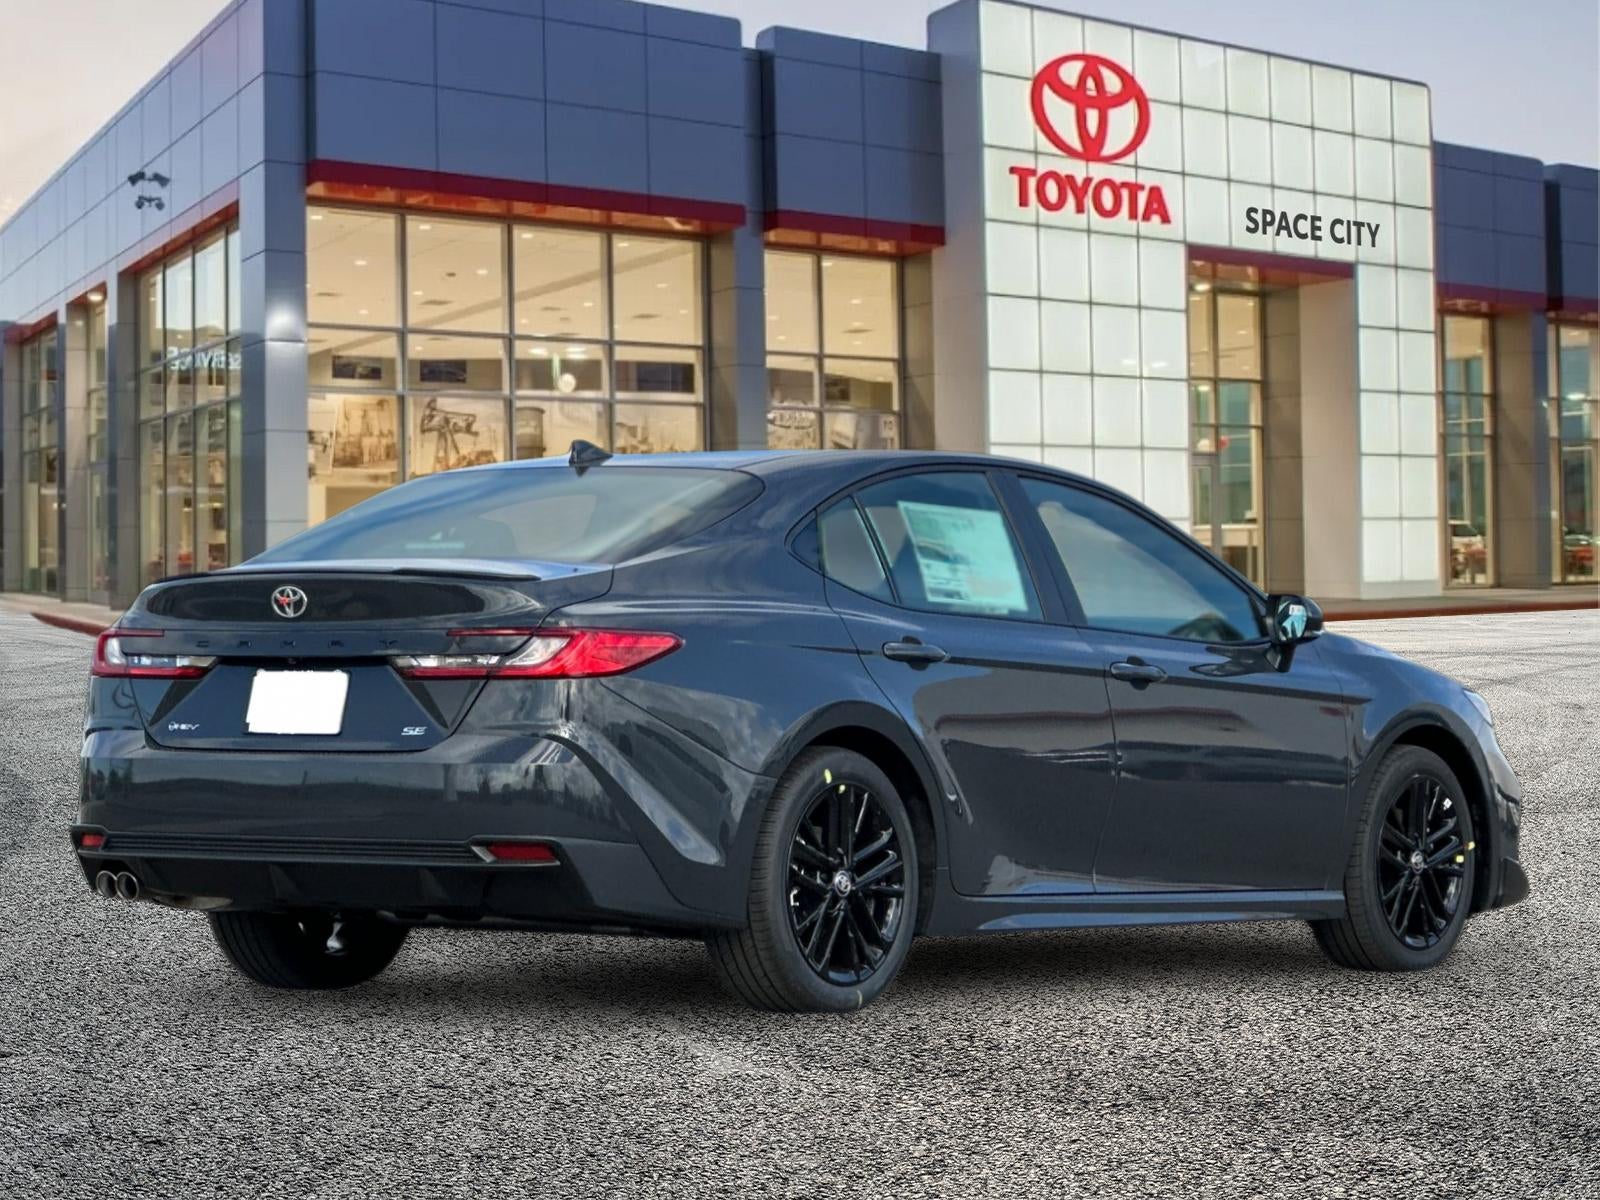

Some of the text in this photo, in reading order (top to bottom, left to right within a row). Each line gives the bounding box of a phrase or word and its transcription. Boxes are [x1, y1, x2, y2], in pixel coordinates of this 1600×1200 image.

[1009, 166, 1171, 224] TOYOTA
[1245, 206, 1380, 248] SPACE CITY
[401, 726, 428, 736] SE
